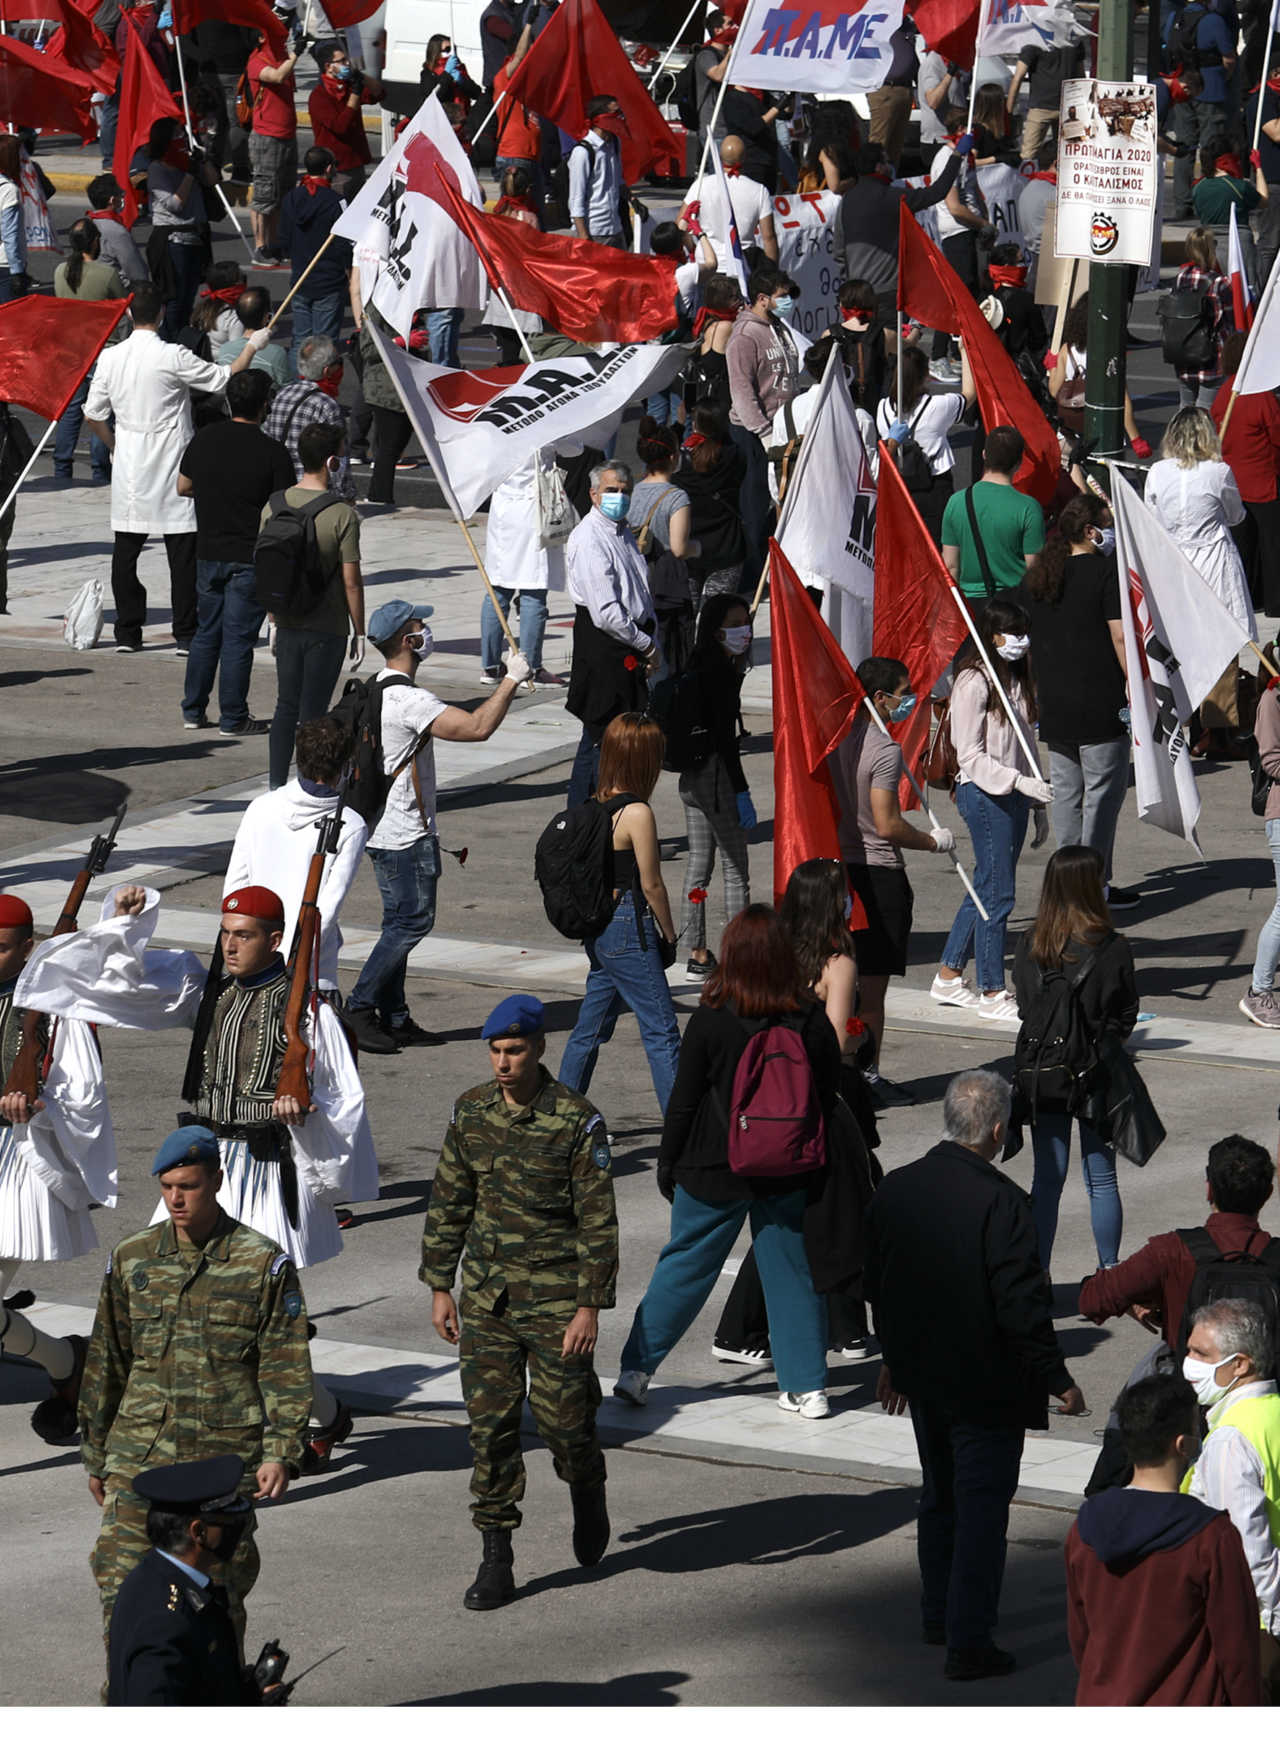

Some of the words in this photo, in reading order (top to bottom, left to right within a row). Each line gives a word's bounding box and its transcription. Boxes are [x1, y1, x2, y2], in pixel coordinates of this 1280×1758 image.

[1127, 148, 1152, 163] 2020
[1122, 166, 1144, 176] ΕΙΝΑΙ
[1073, 173, 1081, 185] Ο
[502, 410, 545, 434] ΜΕΤΩΠΟ
[547, 391, 580, 412] ΑΓΩΝΑ
[582, 346, 638, 393] ΣΠΟΥΔΑΣΤΩΝ
